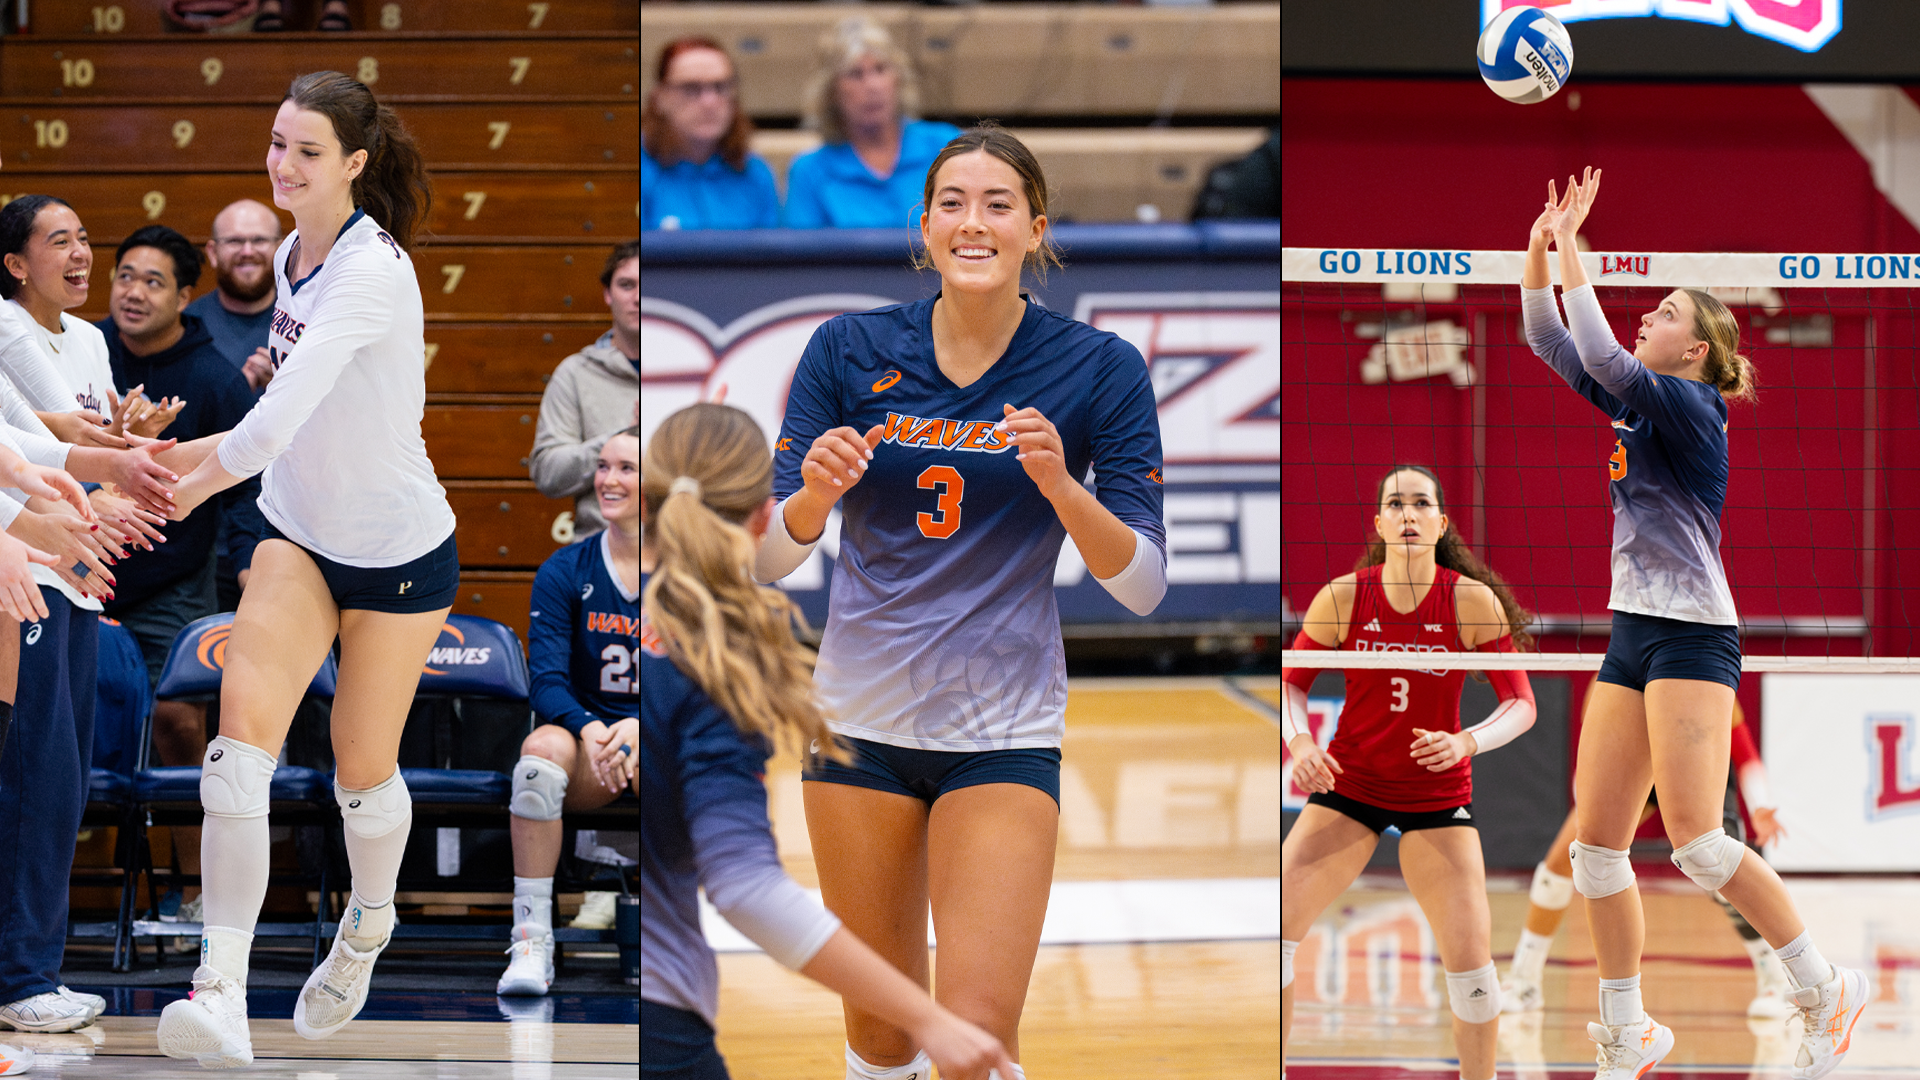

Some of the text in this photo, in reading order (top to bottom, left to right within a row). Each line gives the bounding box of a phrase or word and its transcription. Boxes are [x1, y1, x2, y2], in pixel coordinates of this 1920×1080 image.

[92, 6, 125, 33] 10
[380, 3, 402, 30] 8
[527, 3, 549, 29] 7
[61, 59, 95, 87] 10
[201, 57, 223, 86] 9
[357, 56, 379, 85] 8
[509, 57, 532, 86] 7
[1526, 51, 1558, 92] molten
[34, 119, 69, 148] 10
[171, 119, 195, 148] 9
[488, 121, 511, 149] 7
[142, 190, 166, 220] 9
[463, 191, 487, 220] 7
[1319, 250, 1472, 275] GO LIONS
[1600, 254, 1651, 278] LMU
[1779, 256, 1820, 279] GO
[441, 264, 466, 294] 7
[878, 411, 1018, 454] WAVES
[916, 464, 965, 540] 3
[551, 510, 576, 544] 6
[1389, 676, 1410, 713] 3
